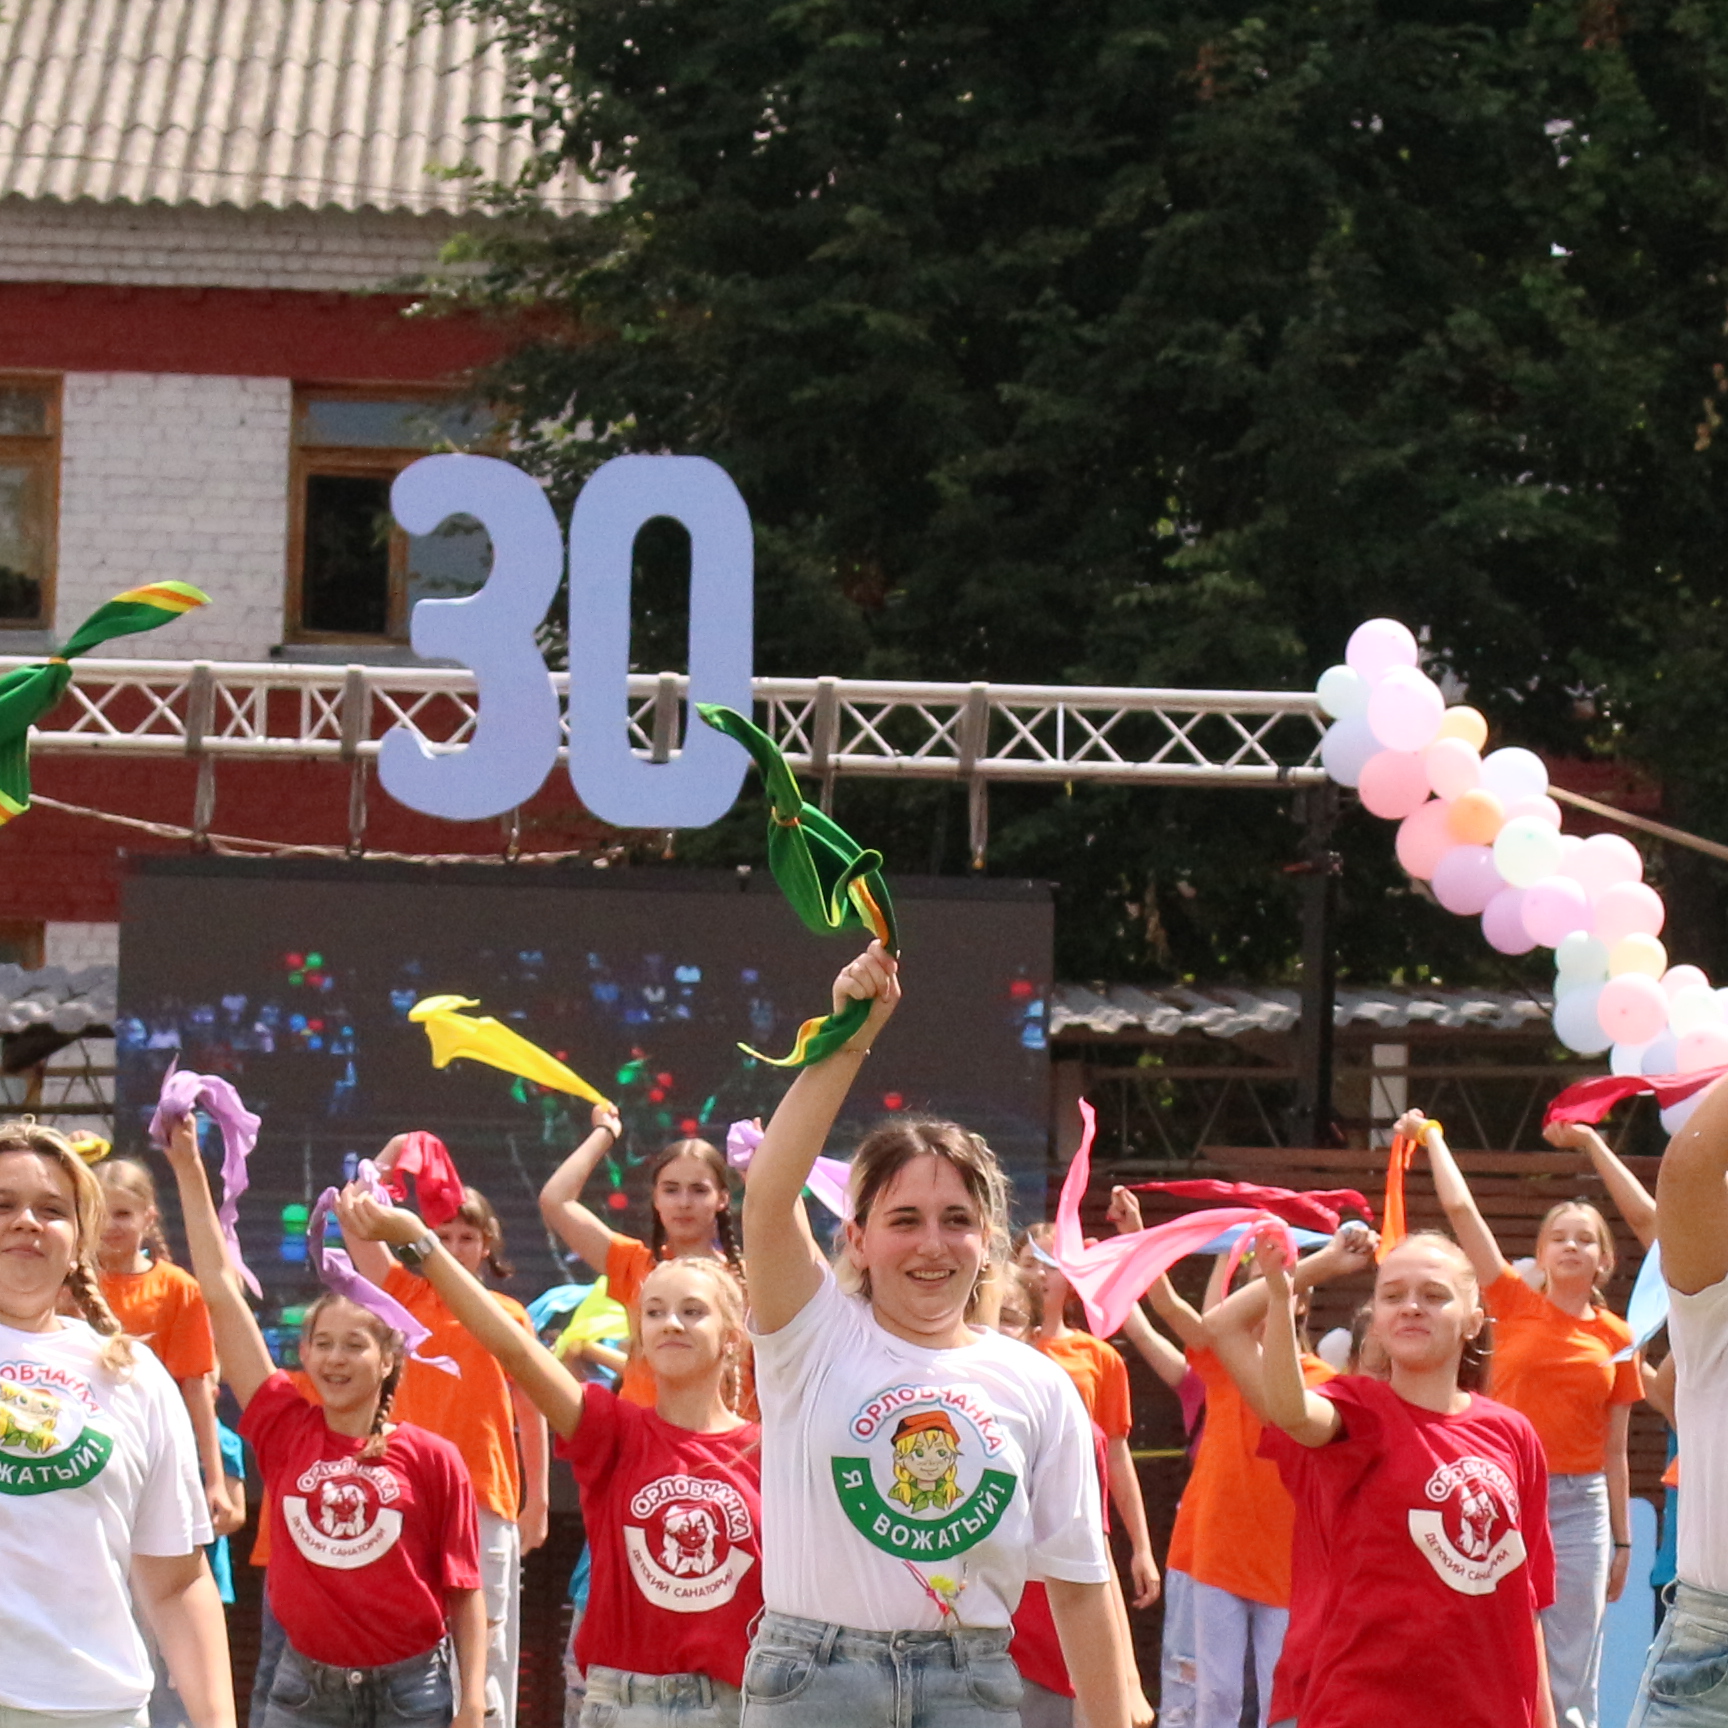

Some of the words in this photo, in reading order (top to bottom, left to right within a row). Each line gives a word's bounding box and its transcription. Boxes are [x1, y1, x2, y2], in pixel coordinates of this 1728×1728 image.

[377, 453, 755, 829] 30
[855, 1387, 1003, 1452] ОРЛОВЧАНКА
[633, 1477, 750, 1541] ОРЛОВЧАНКА
[842, 1469, 863, 1489] Я
[872, 1482, 1006, 1551] ВОЖАТЫЙ!
